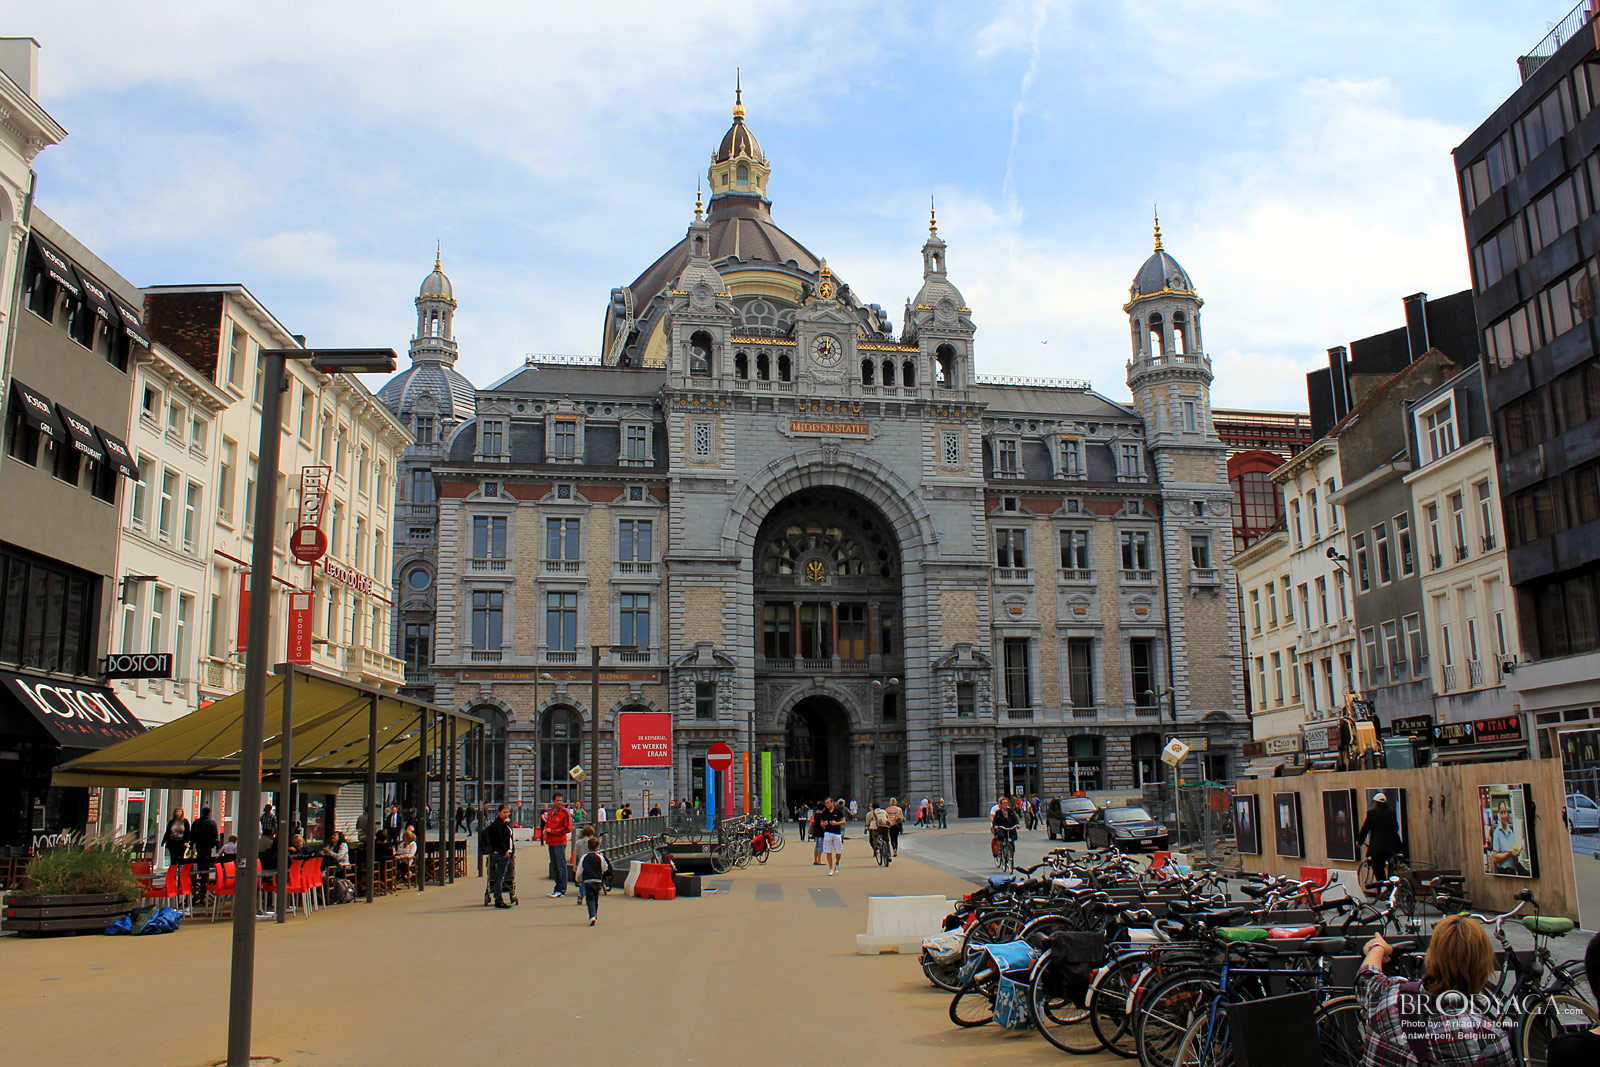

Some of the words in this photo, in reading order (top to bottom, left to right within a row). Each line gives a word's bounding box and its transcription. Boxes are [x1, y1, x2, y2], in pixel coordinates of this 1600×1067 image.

[50, 270, 79, 296] RESTAURANT
[97, 306, 109, 320] GRILL
[126, 327, 149, 349] RESTAURANT
[40, 422, 54, 435] GRILL
[792, 422, 867, 434] MIDDENSTATIE
[74, 440, 102, 461] RESTAURANT
[120, 465, 131, 476] GRILL
[302, 468, 321, 527] HOTEL
[109, 654, 167, 672] BOSTON
[15, 678, 128, 724] BOSTON
[1400, 720, 1428, 729] JENNY
[1487, 719, 1507, 731] ITAI
